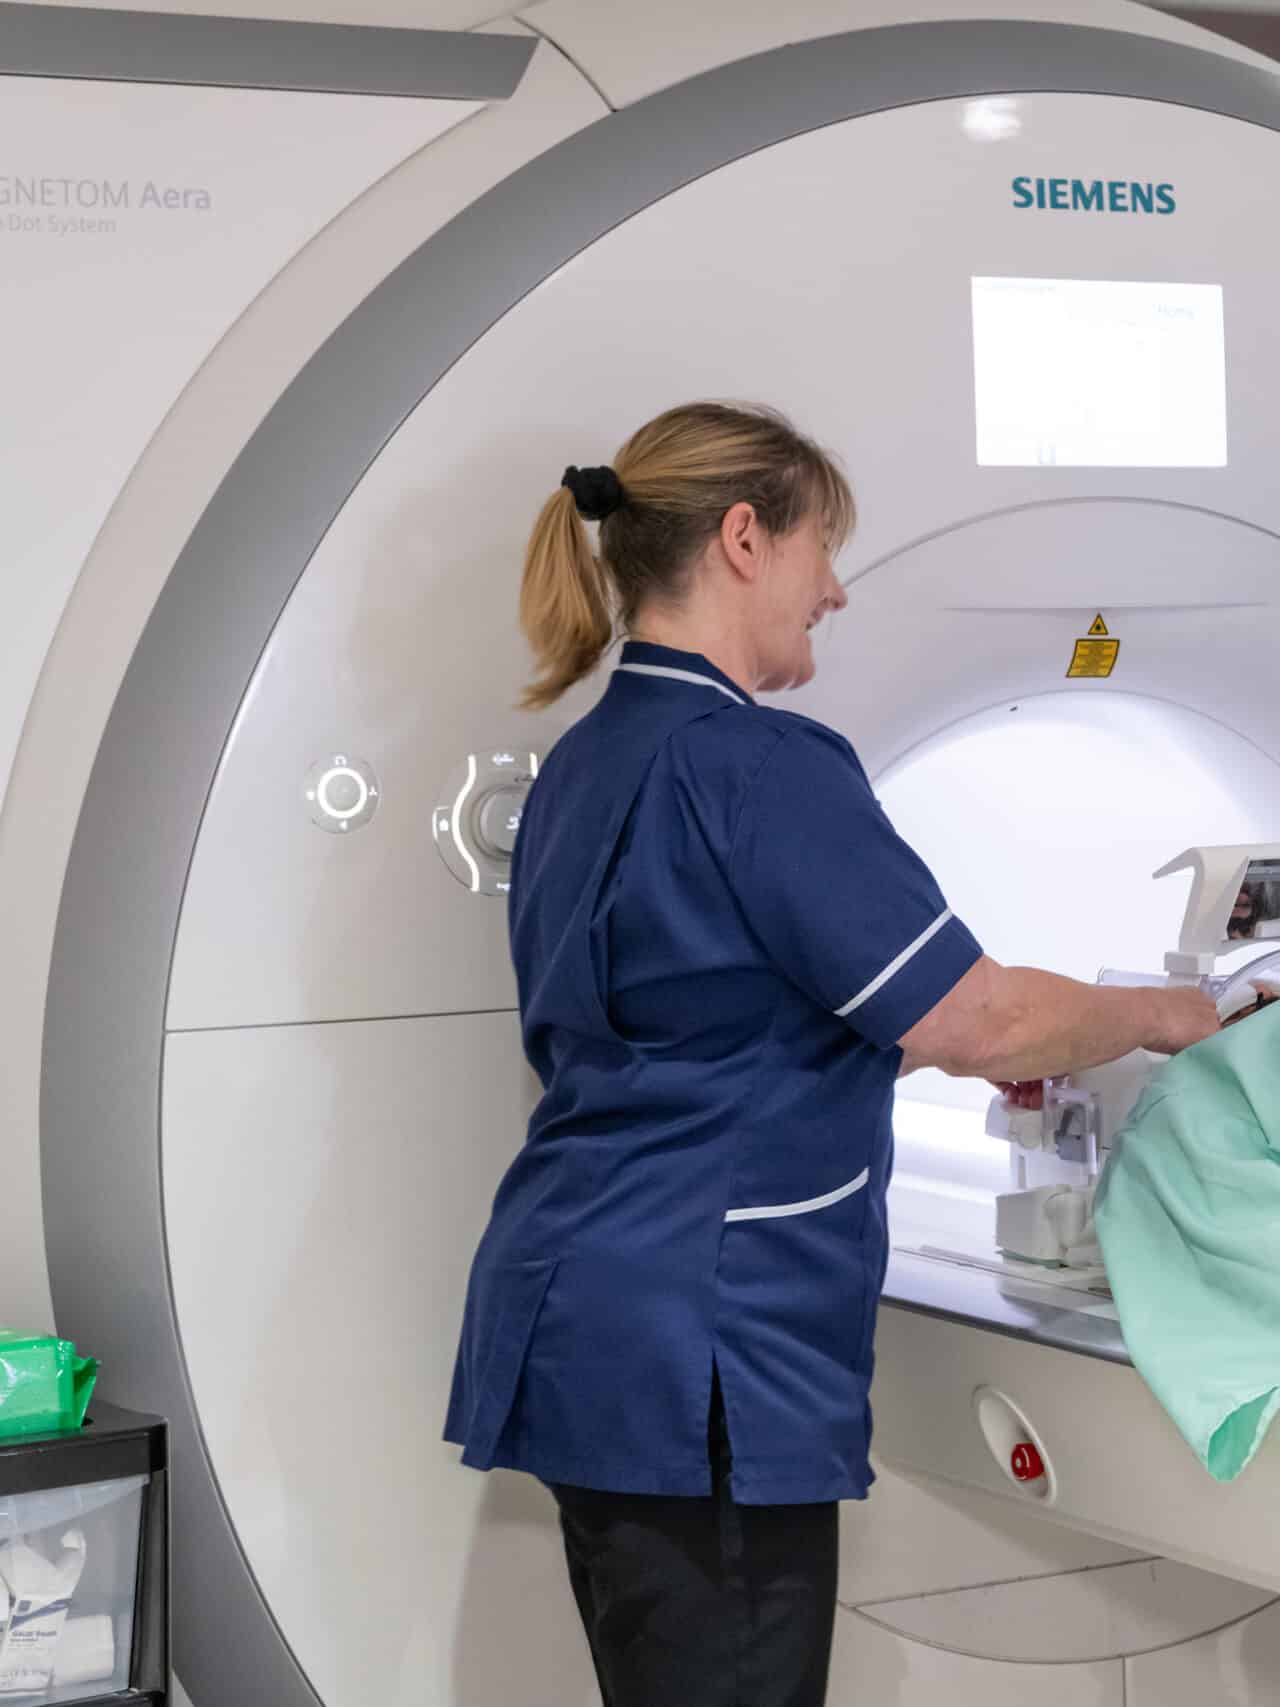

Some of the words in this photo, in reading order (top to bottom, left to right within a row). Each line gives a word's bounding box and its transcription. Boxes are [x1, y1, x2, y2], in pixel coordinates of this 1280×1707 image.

[139, 180, 211, 210] Aera
[1011, 176, 1176, 215] SIEMENS
[48, 215, 117, 238] System
